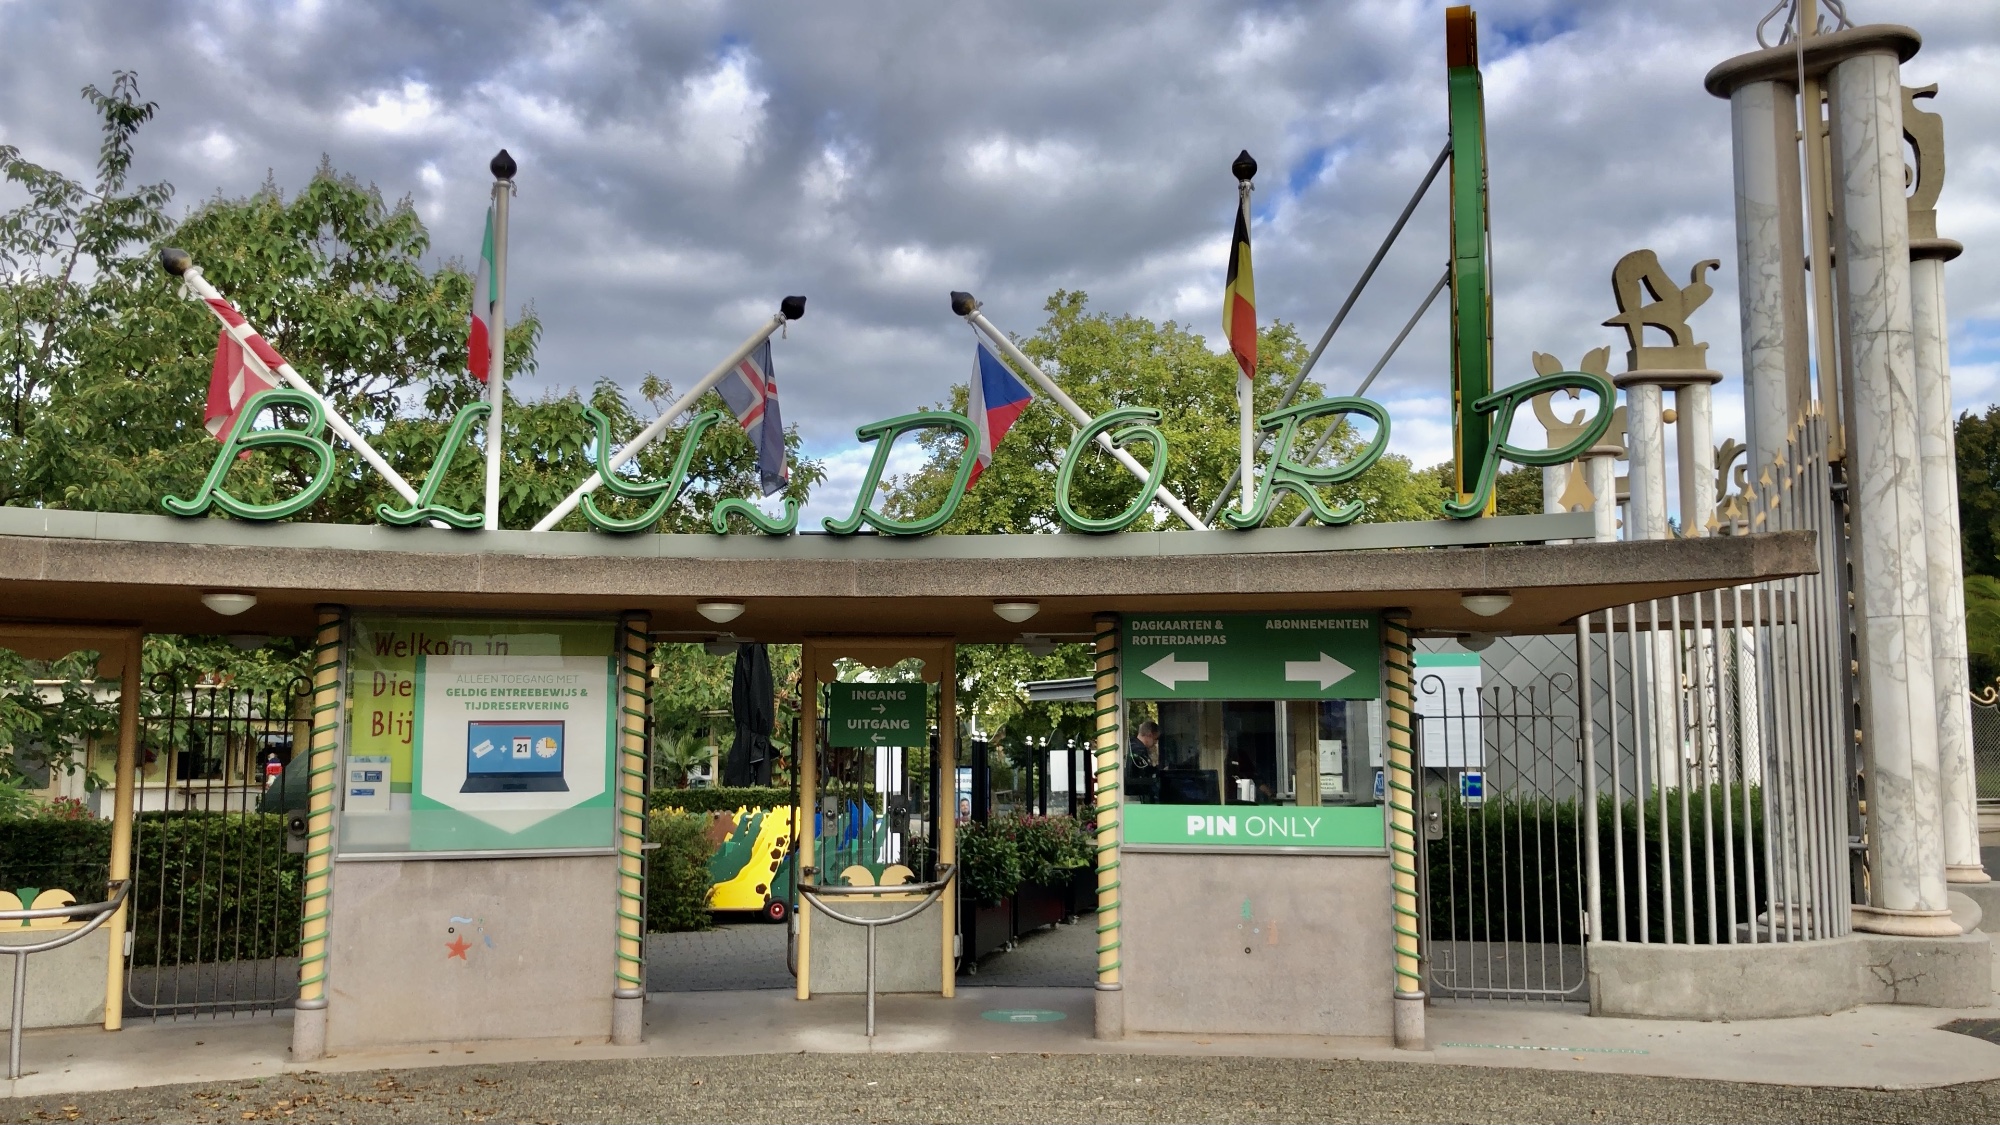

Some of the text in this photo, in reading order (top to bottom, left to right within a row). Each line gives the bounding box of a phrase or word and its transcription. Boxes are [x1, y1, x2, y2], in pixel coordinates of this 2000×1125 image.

[1132, 620, 1224, 631] DAGKAARTEN &
[1265, 619, 1370, 630] ABONNEMENTEN
[374, 631, 509, 658] Welkom in
[1132, 634, 1227, 645] ROTTERDAMPAS
[456, 674, 579, 684] ALLEEN TOEGANG MET
[446, 688, 588, 697] GELDIG ENTREEBEWIJS &
[851, 690, 907, 701] INGANG
[464, 701, 570, 711] TIJDRESERVERING
[847, 718, 910, 730] UITGANG
[516, 743, 528, 753] 21
[1186, 815, 1322, 838] PIN ONLY
